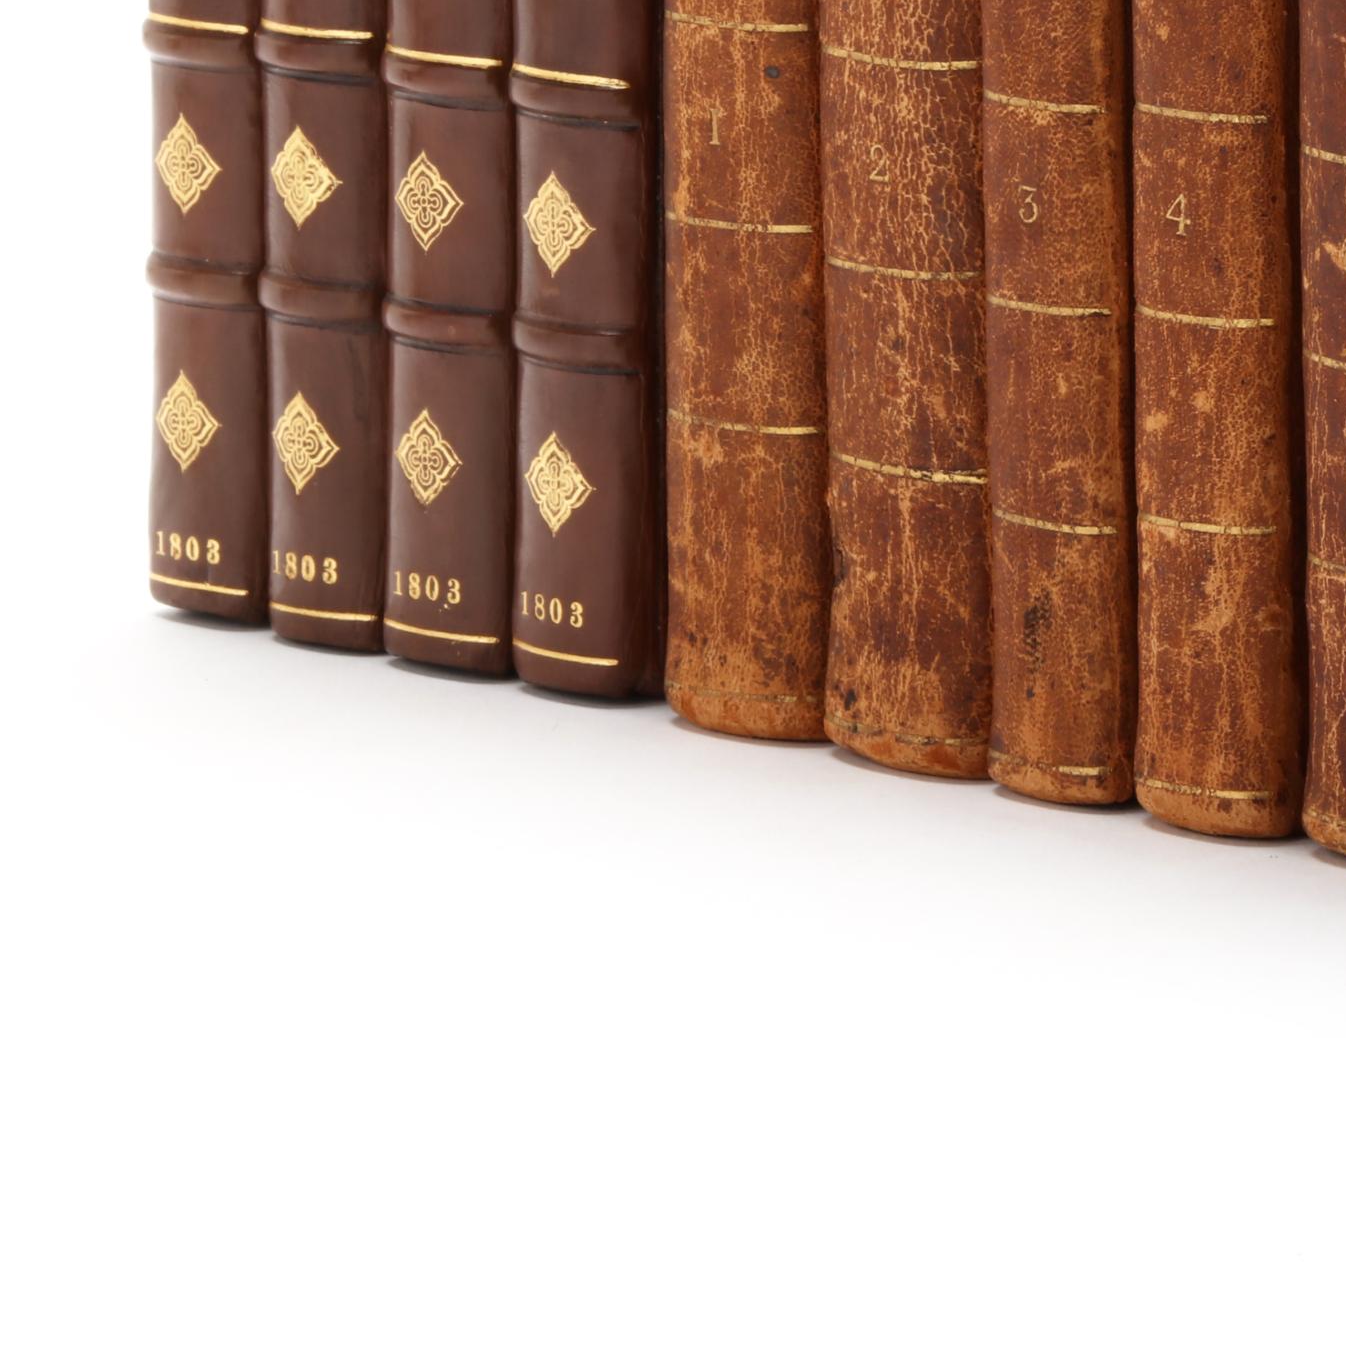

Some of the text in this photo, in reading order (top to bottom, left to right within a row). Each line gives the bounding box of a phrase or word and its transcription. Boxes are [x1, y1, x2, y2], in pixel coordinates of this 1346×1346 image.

[709, 108, 720, 145] 1
[869, 144, 890, 182] 2
[1019, 186, 1039, 223] 3
[1165, 193, 1190, 236] 4
[155, 531, 220, 565] 1803
[272, 550, 338, 584] 1803
[394, 571, 461, 604] 1803
[520, 591, 584, 628] 1803
